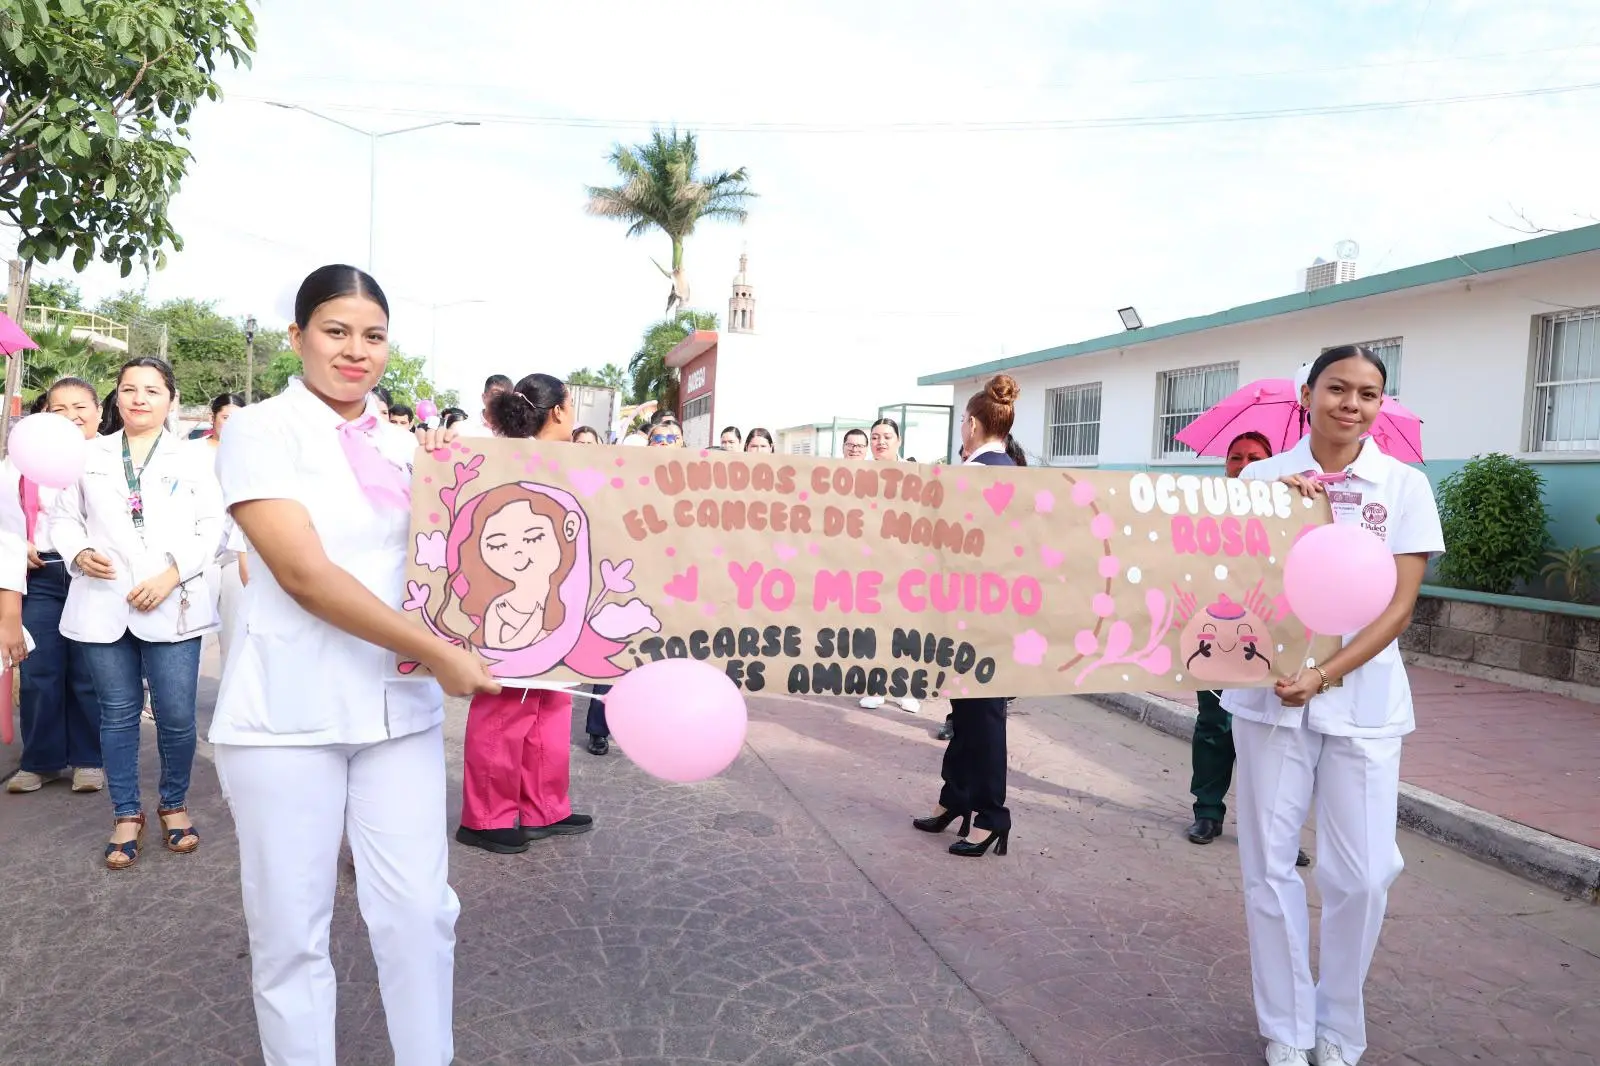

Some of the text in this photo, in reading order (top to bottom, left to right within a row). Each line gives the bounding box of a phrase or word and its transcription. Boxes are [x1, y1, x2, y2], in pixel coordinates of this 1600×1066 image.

[655, 460, 944, 509] UNIDAS CONTRA
[1129, 473, 1291, 519] OCTUBRE
[622, 500, 985, 557] EL CANCER DE MAMA
[1170, 515, 1271, 557] ROSA
[728, 561, 1042, 616] YO ME CUIDO
[725, 660, 945, 699] ES AMARSE!
[814, 627, 876, 660] SIN
[891, 627, 996, 684] MIEDO
